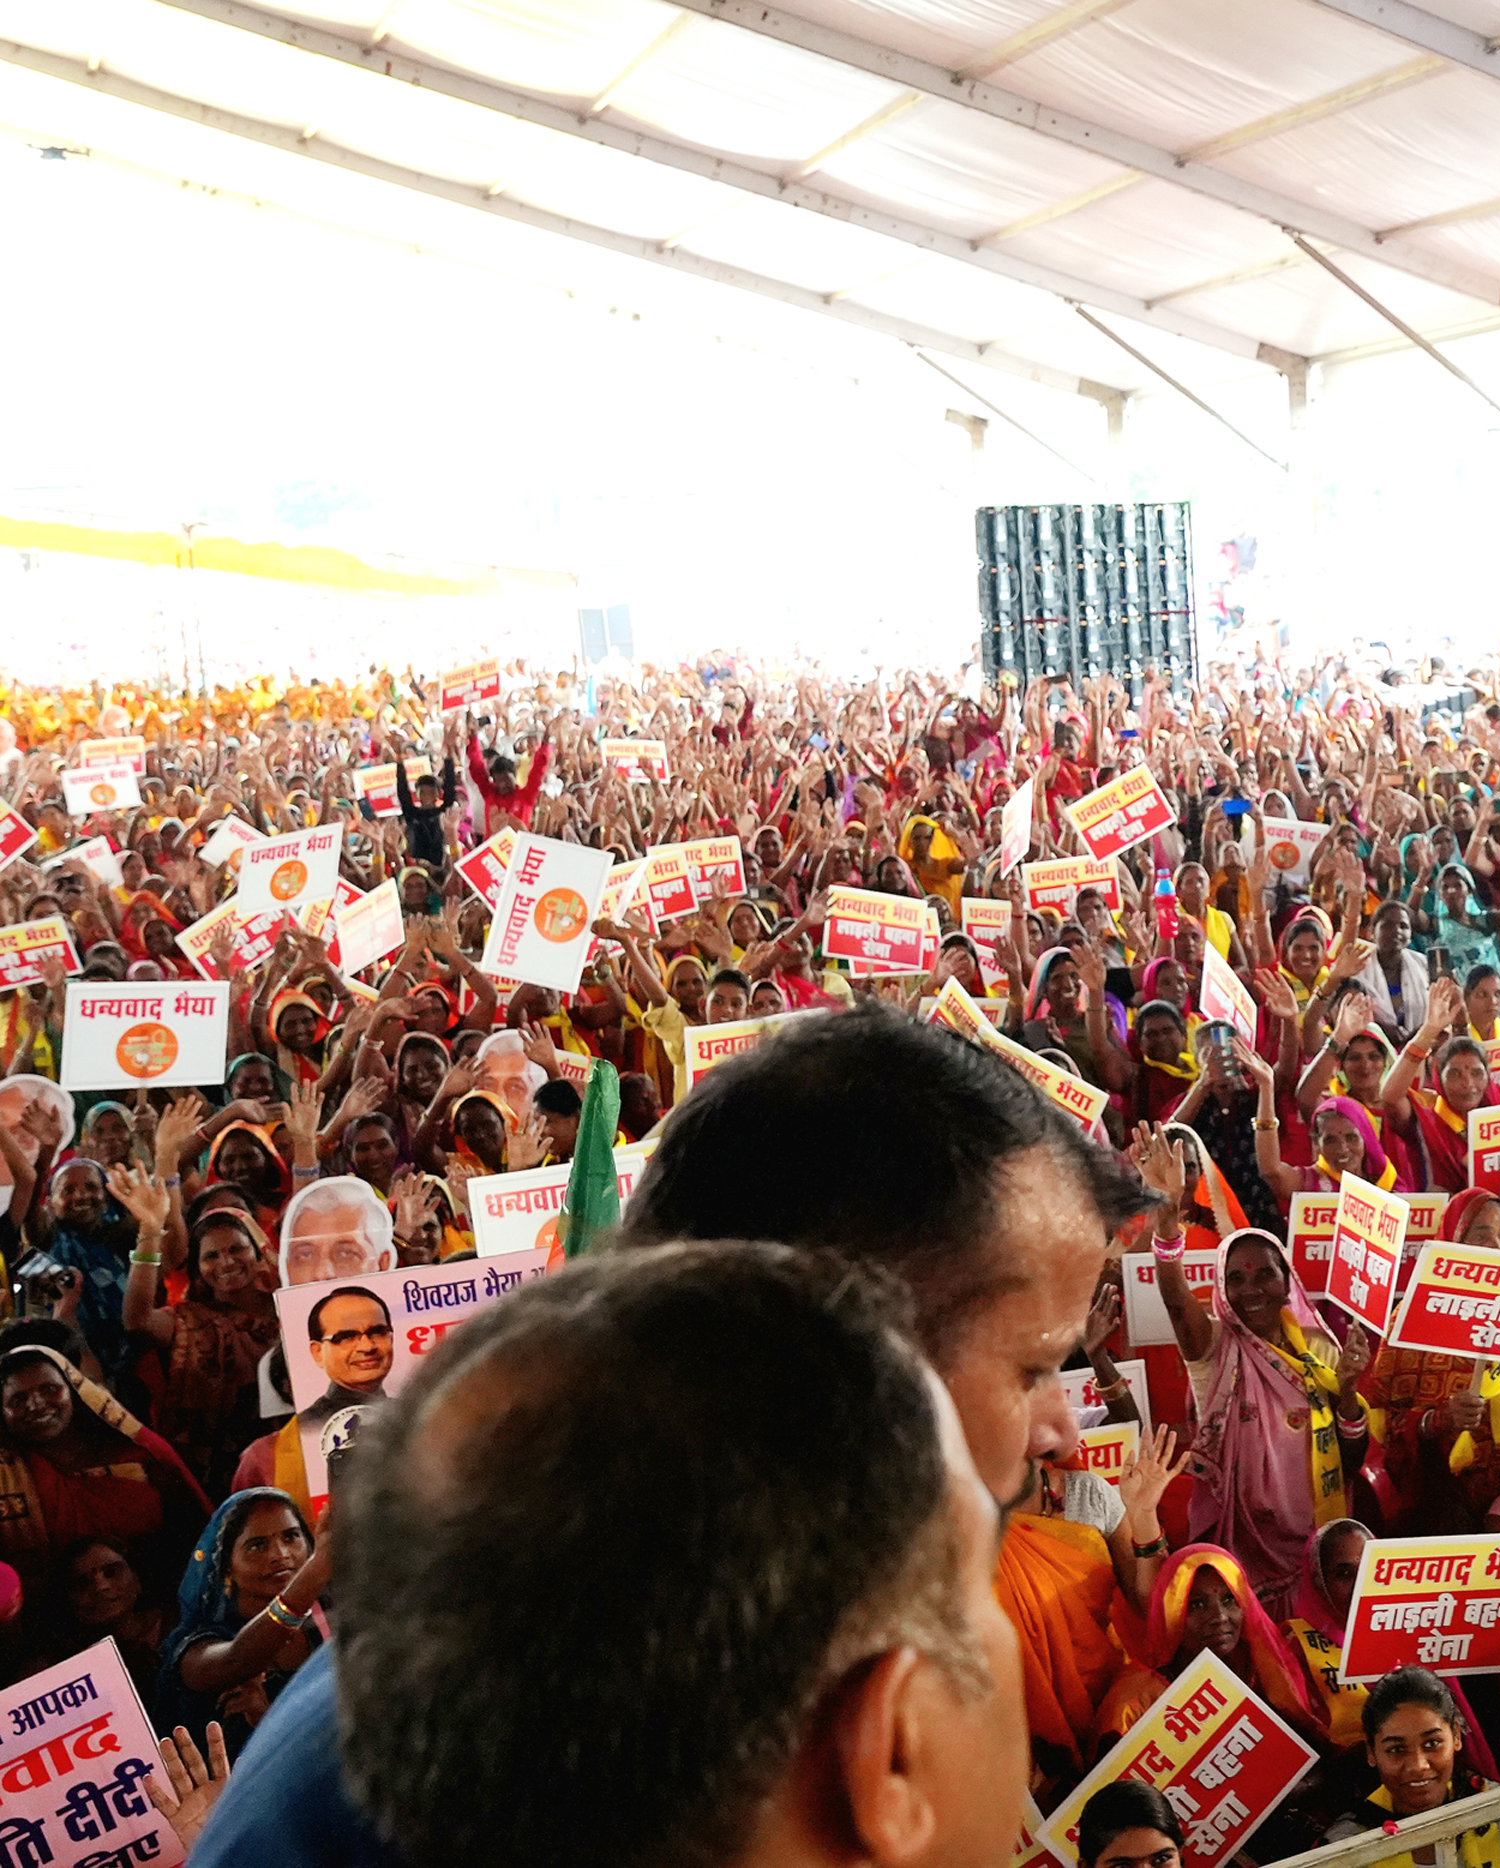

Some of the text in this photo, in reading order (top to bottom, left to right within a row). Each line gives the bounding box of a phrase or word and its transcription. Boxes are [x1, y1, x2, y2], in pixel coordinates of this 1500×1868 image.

[1076, 776, 1148, 823] धन्यवाद भैया
[251, 834, 334, 863] धन्यवाद भैया
[516, 846, 546, 885] भैया
[1031, 867, 1078, 883] धन्यवाद
[836, 897, 919, 922] धन्यवाद भैया
[498, 893, 535, 966] धन्यवाद
[81, 990, 216, 1020] धन्यवाद भैया
[1056, 1080, 1094, 1111] भैया
[486, 1184, 567, 1218] धन्यवा
[1343, 1191, 1376, 1236] धन्यवाद
[1378, 1203, 1399, 1244] भैया
[403, 1280, 476, 1313] शिवराज
[1374, 1555, 1476, 1585] धन्यवाद
[1370, 1593, 1458, 1633] लाड़ली
[1417, 1629, 1474, 1663] सेना
[7, 1673, 99, 1735] आपका
[1164, 1678, 1228, 1742] भैया
[1190, 1714, 1264, 1790] बहना
[1185, 1790, 1250, 1856] सेना
